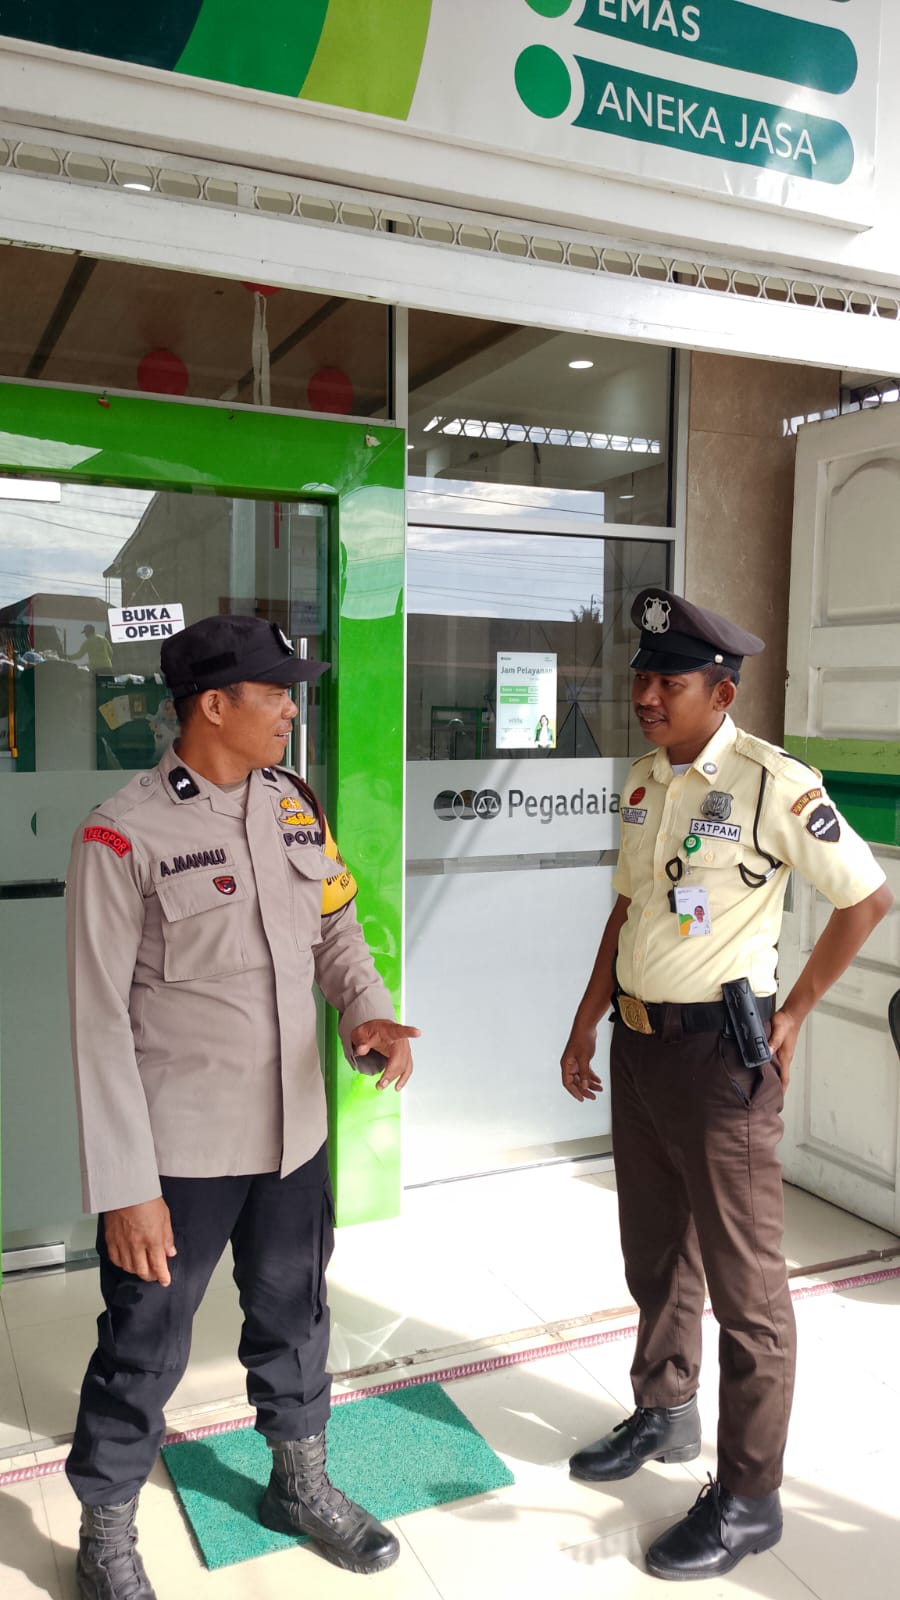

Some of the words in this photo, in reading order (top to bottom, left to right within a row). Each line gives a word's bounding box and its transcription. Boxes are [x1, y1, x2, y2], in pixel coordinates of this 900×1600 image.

[597, 81, 726, 144] ANEKA
[734, 113, 817, 165] JASA
[122, 607, 171, 622] BUKA
[125, 623, 173, 638] OPEN
[500, 666, 515, 674] Jam
[508, 787, 621, 824] Pegadaia
[693, 822, 738, 838] SATPAM
[160, 848, 227, 877] A.MANALU
